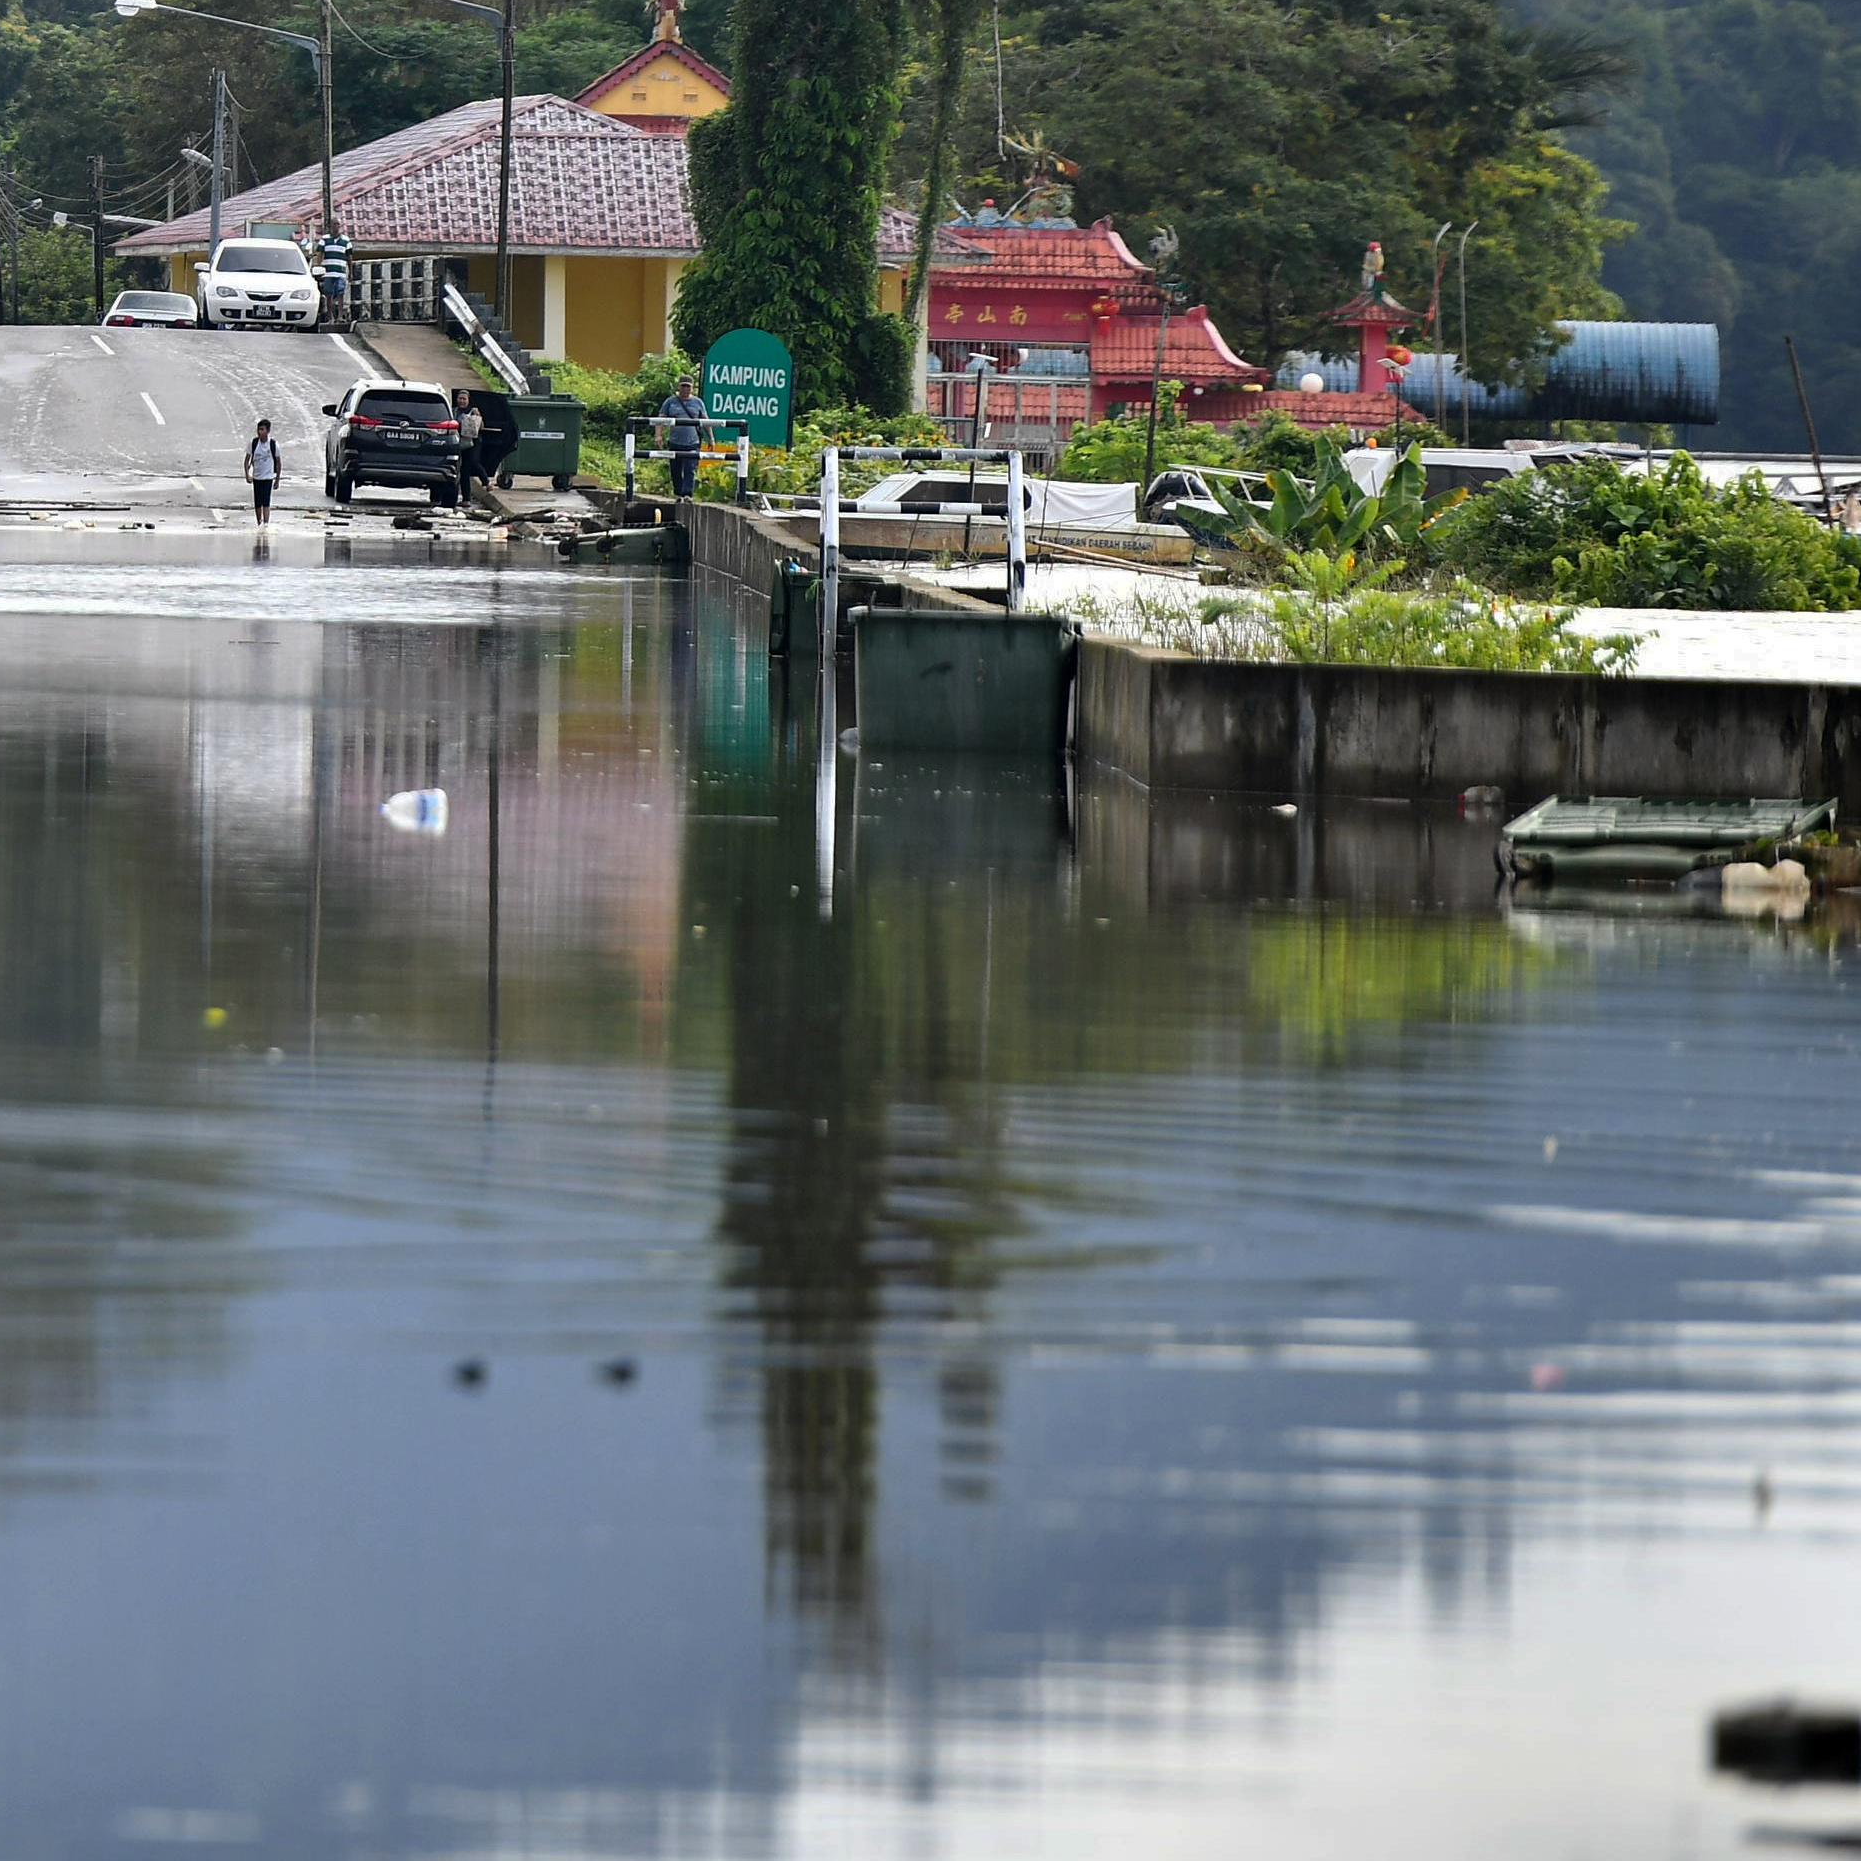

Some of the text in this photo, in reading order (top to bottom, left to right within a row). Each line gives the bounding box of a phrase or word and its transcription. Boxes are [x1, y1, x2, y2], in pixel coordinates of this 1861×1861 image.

[709, 364, 786, 389] KAMPUNG
[712, 393, 778, 417] DAGANG
[1088, 539, 1120, 549] DAERAH
